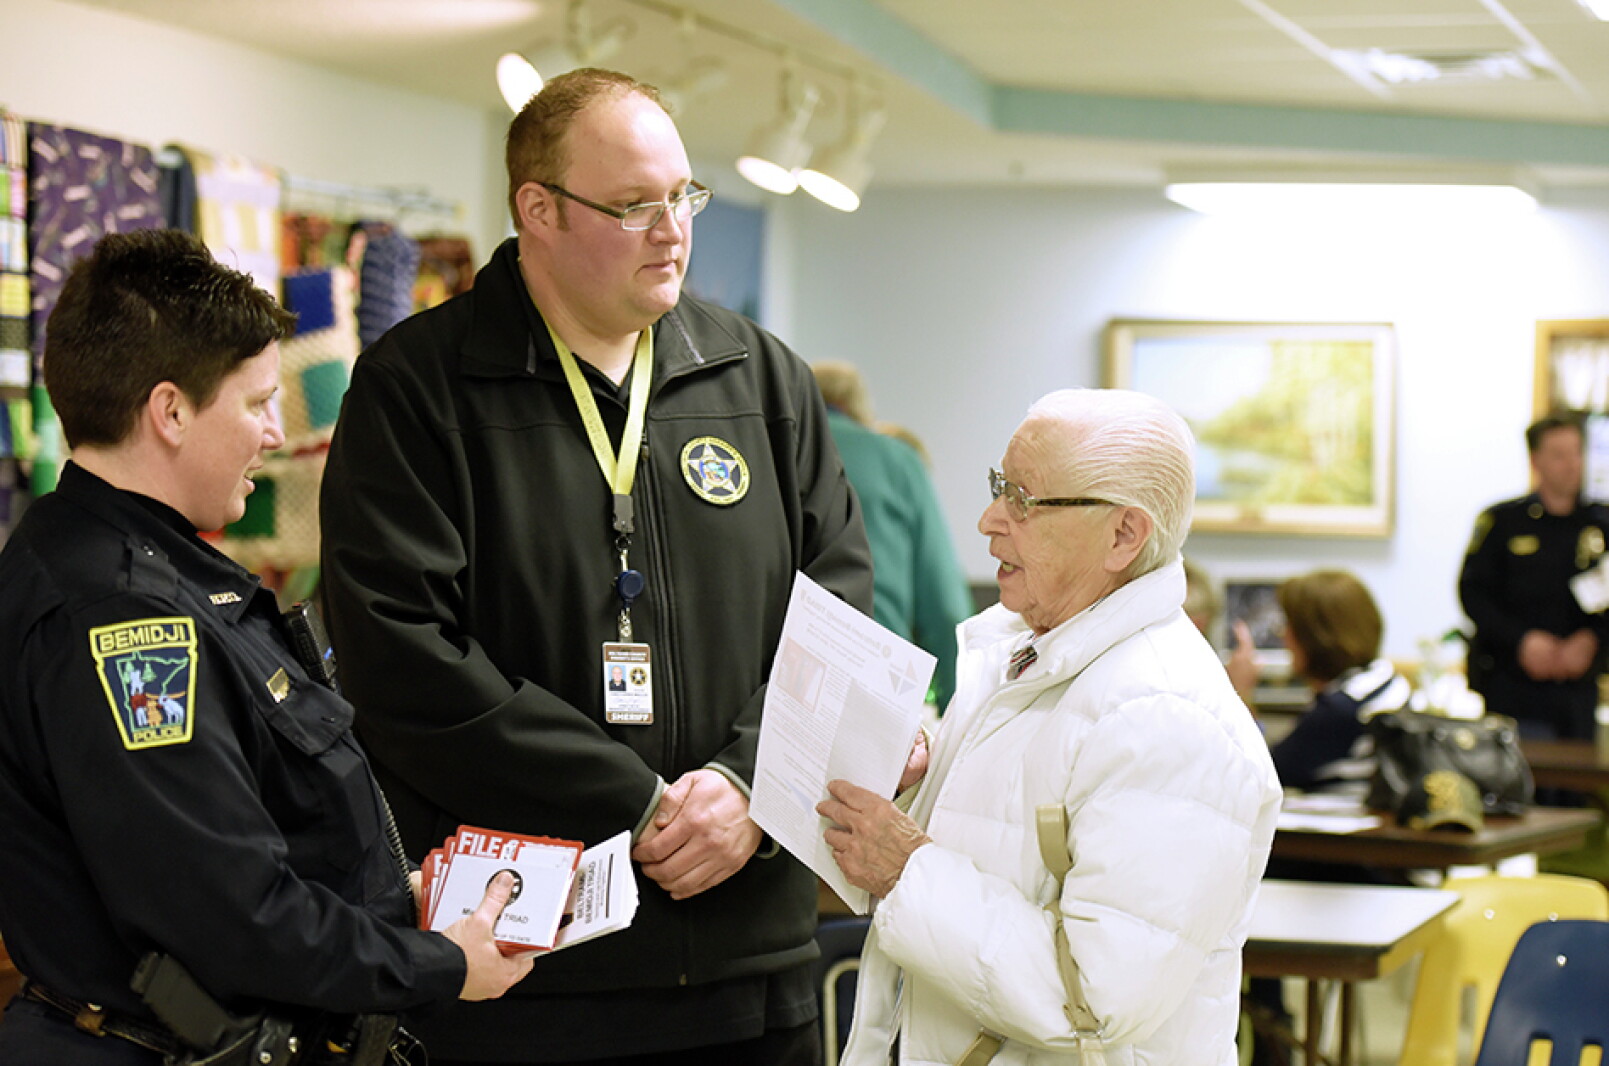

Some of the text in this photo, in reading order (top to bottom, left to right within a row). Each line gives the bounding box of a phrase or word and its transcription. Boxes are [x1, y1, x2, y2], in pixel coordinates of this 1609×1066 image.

[100, 624, 186, 652] BEMIDJI
[133, 726, 184, 743] POLICE
[458, 832, 503, 859] FILE
[504, 913, 530, 925] TRIAD
